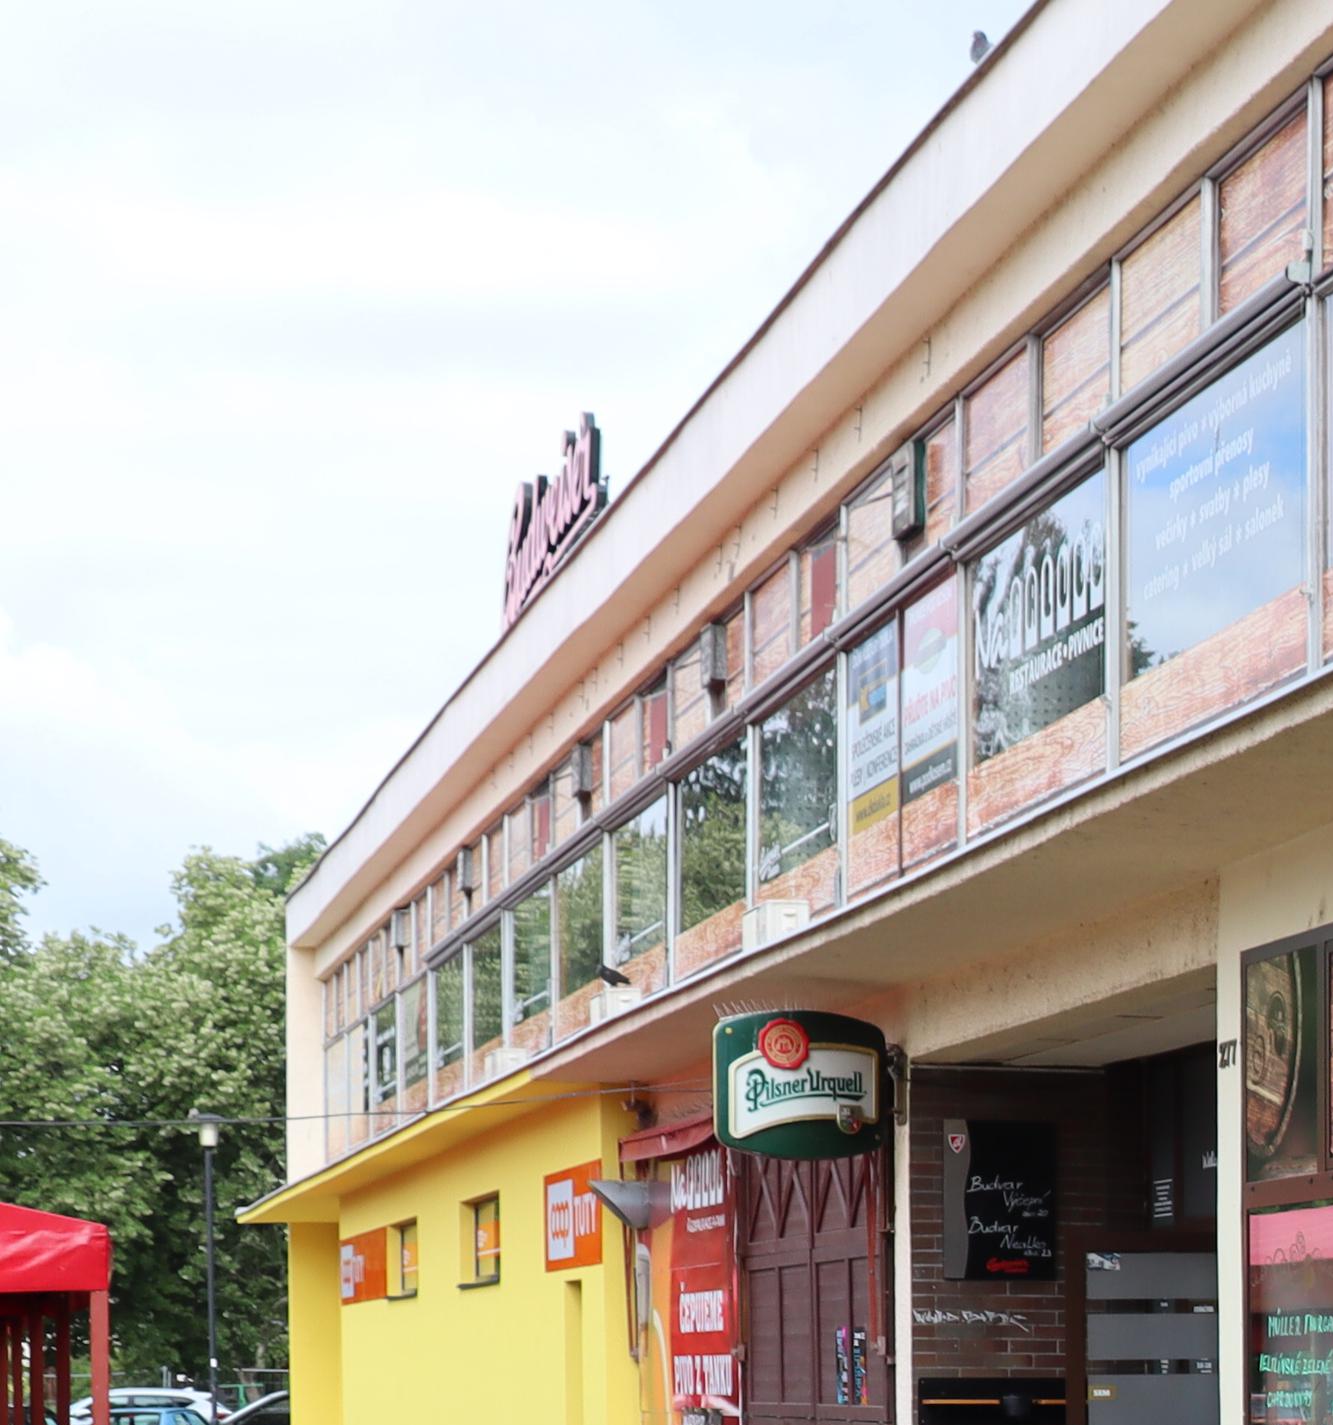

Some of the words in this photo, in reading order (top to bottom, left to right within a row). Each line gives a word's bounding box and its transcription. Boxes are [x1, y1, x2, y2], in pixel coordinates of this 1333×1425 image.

[1178, 421, 1199, 457] pivo
[1169, 449, 1214, 504] sportovní
[1214, 428, 1254, 477] přenosy
[1199, 482, 1231, 525] svatby
[1242, 460, 1270, 502] plesy
[745, 1068, 809, 1113] Pilsner
[679, 1281, 725, 1333] ČEPUJEME
[674, 1355, 693, 1396] PIVO
[695, 1354, 703, 1395] Z
[703, 1354, 733, 1397] TANKU
